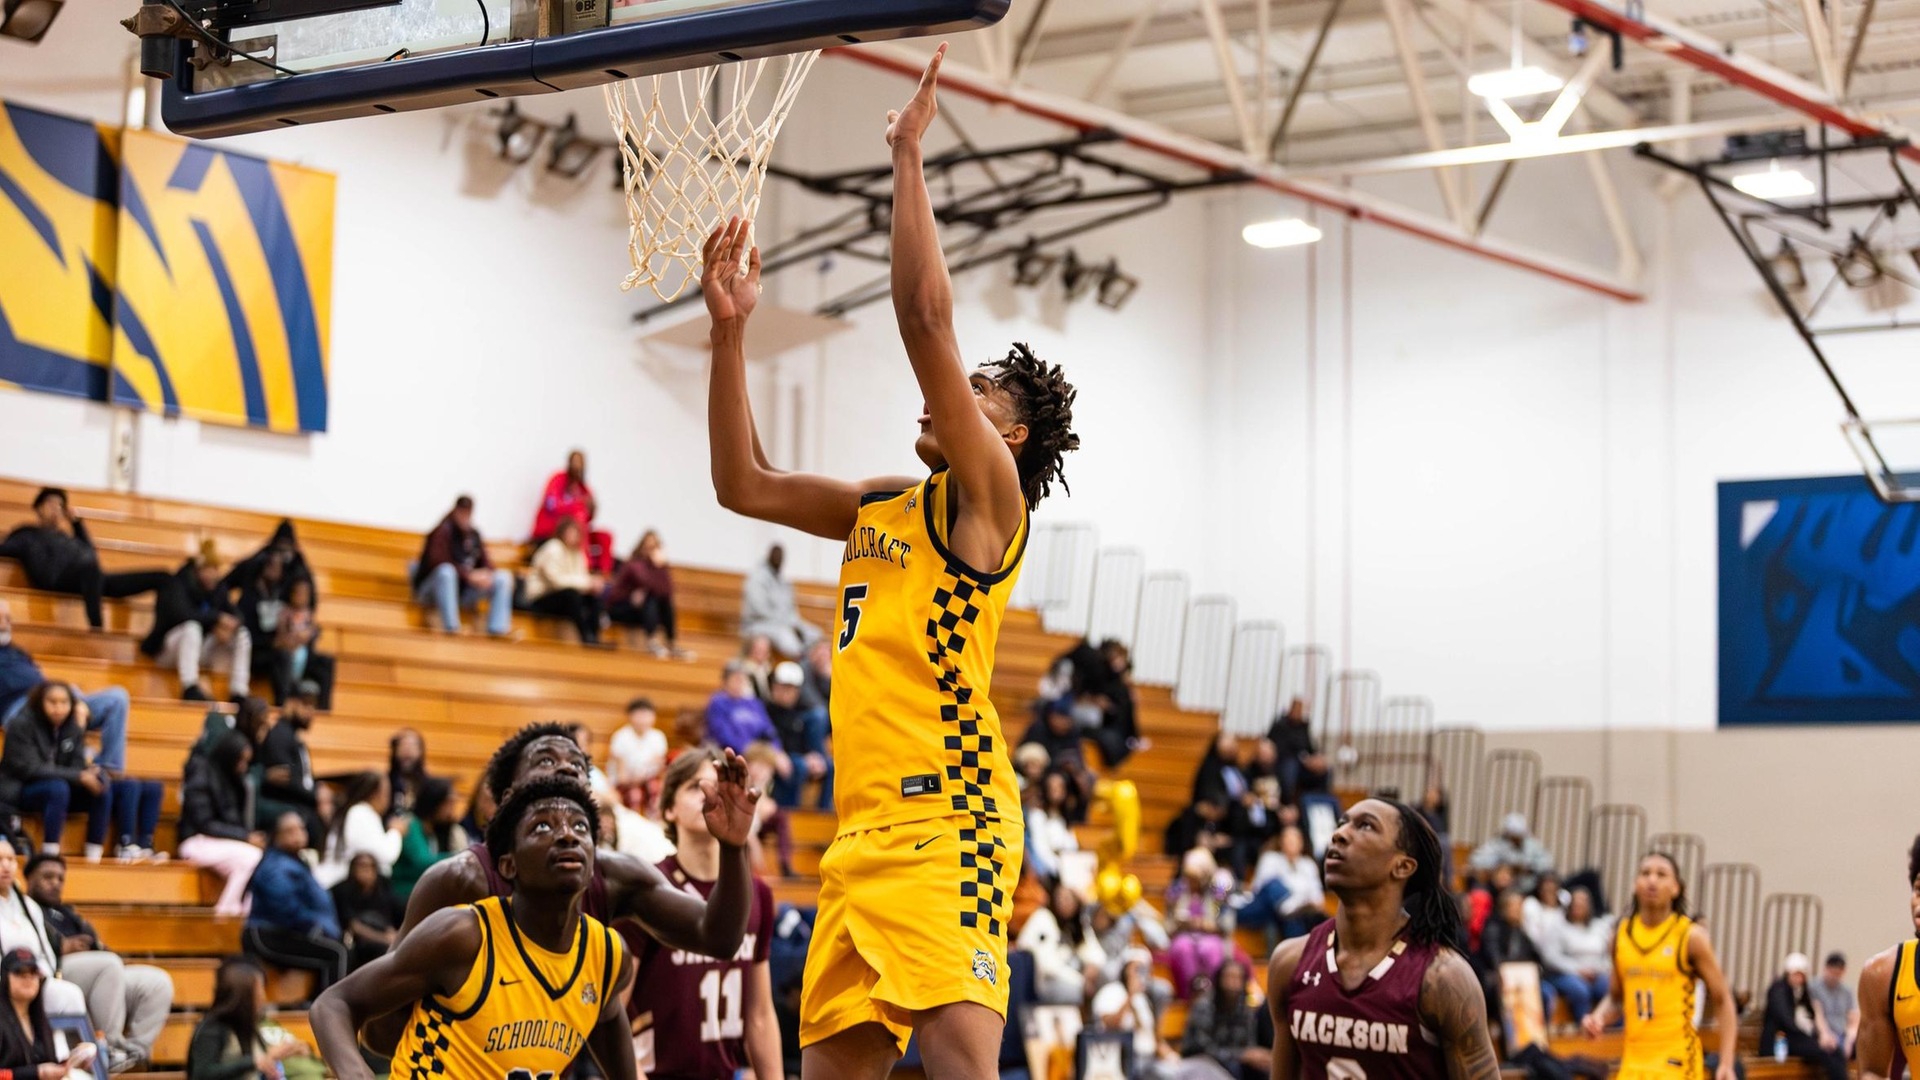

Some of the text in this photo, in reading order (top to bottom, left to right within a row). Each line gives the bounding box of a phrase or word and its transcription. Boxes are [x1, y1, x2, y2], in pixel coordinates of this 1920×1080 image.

[842, 526, 911, 570] OLCRAFT
[839, 582, 868, 653] 5
[928, 779, 934, 788] L
[699, 967, 743, 1042] 11
[484, 1019, 584, 1058] SCHOOLCRAF
[1290, 1009, 1408, 1054] JACKSON
